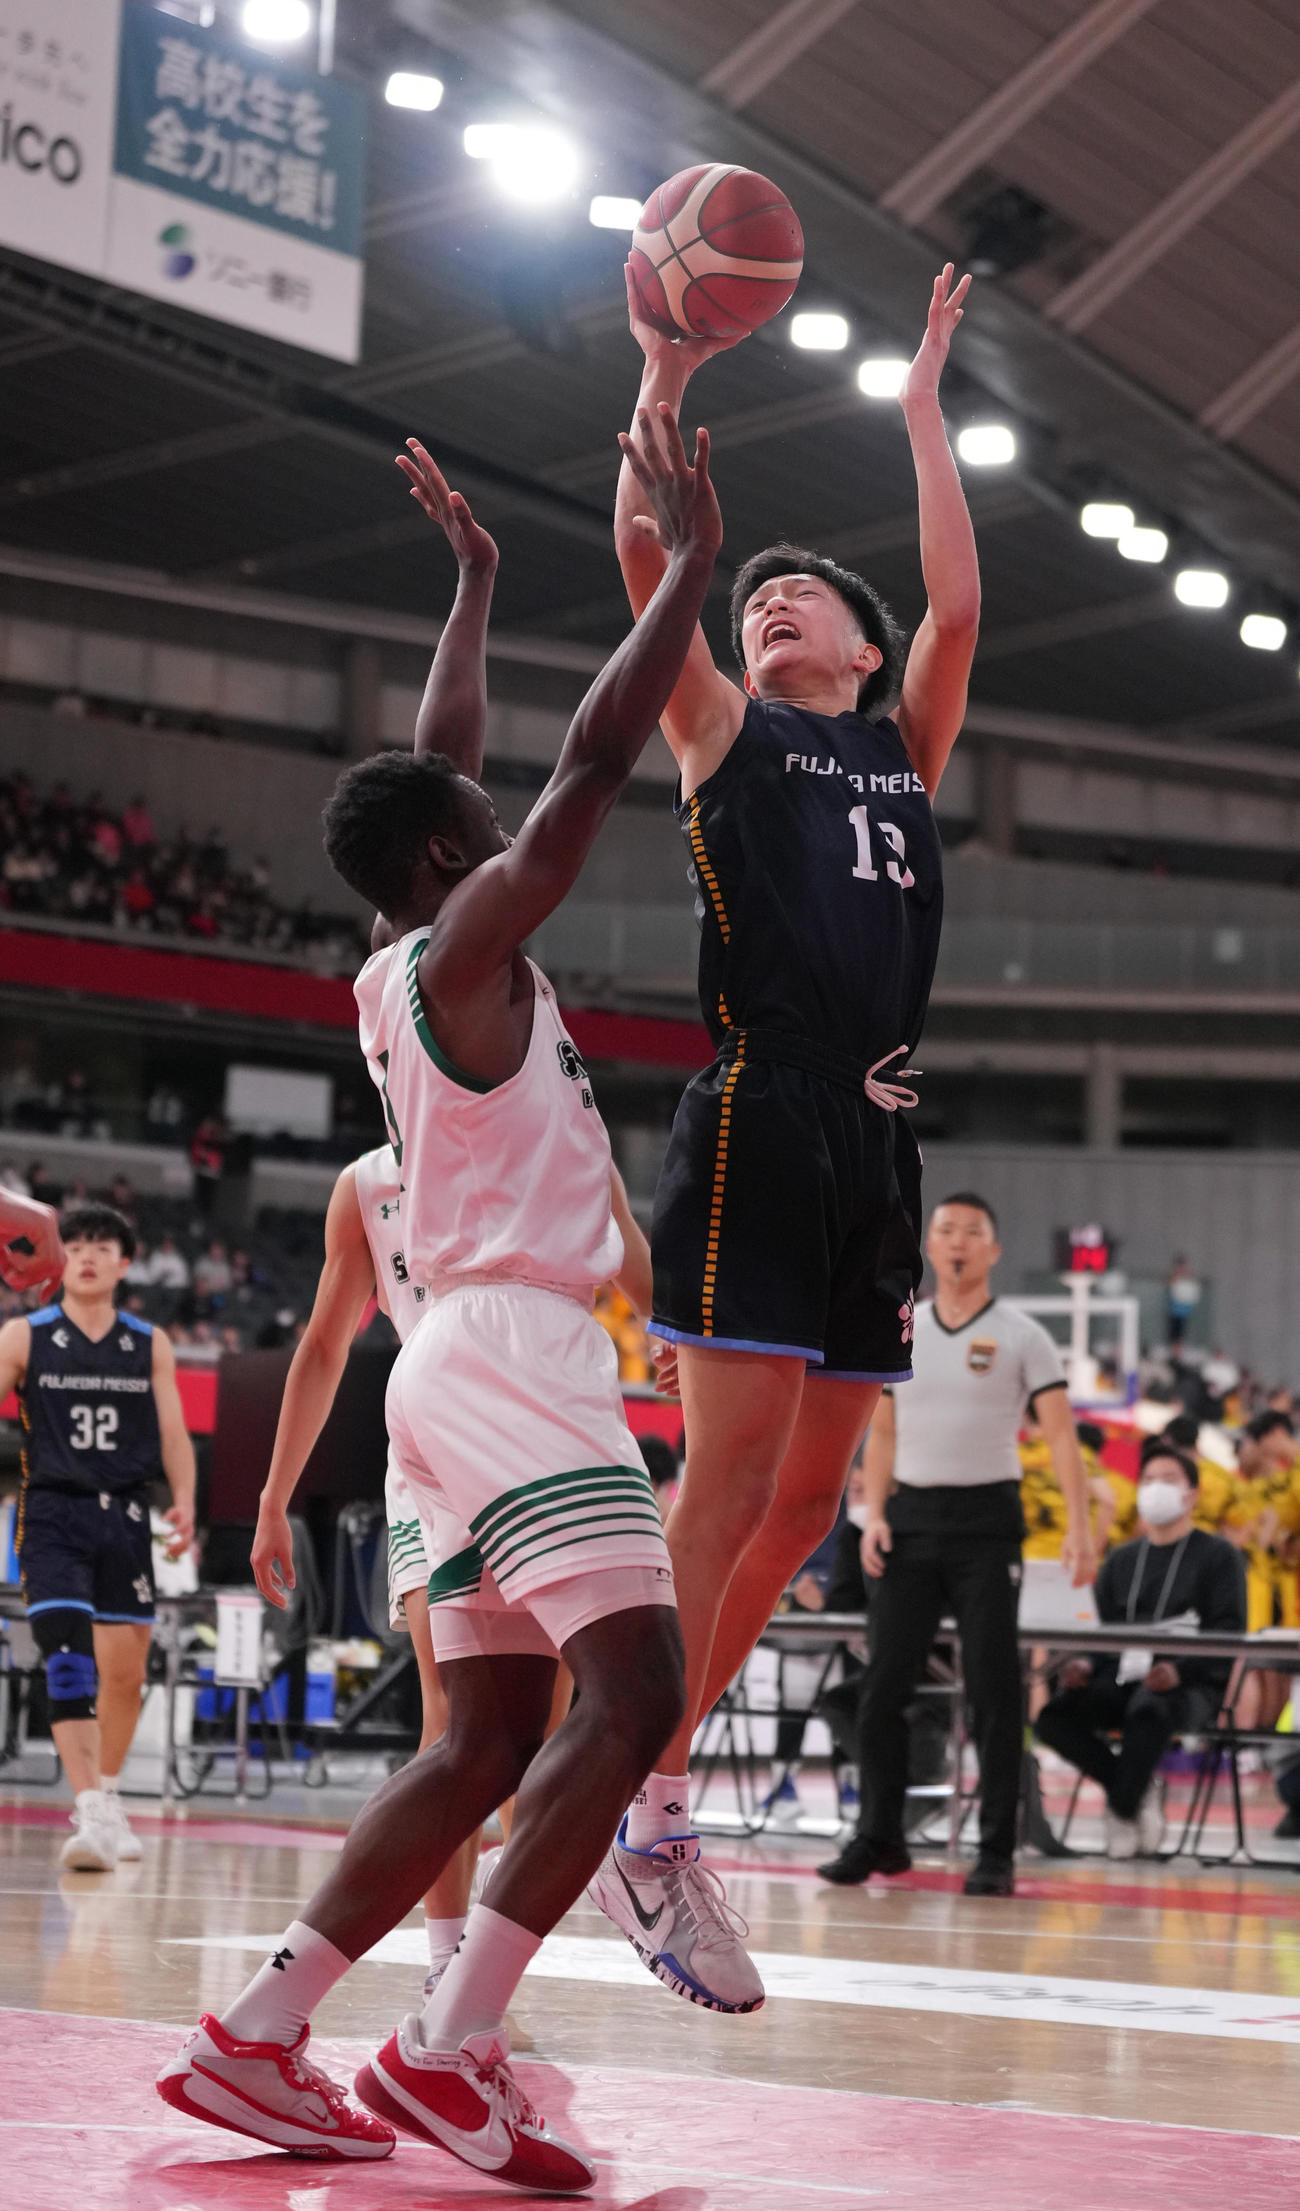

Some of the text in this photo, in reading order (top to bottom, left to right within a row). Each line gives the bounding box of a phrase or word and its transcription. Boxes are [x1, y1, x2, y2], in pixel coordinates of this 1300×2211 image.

[156, 37, 331, 157] 高校生を
[0, 101, 82, 185] ico
[70, 1405, 119, 1450] 32
